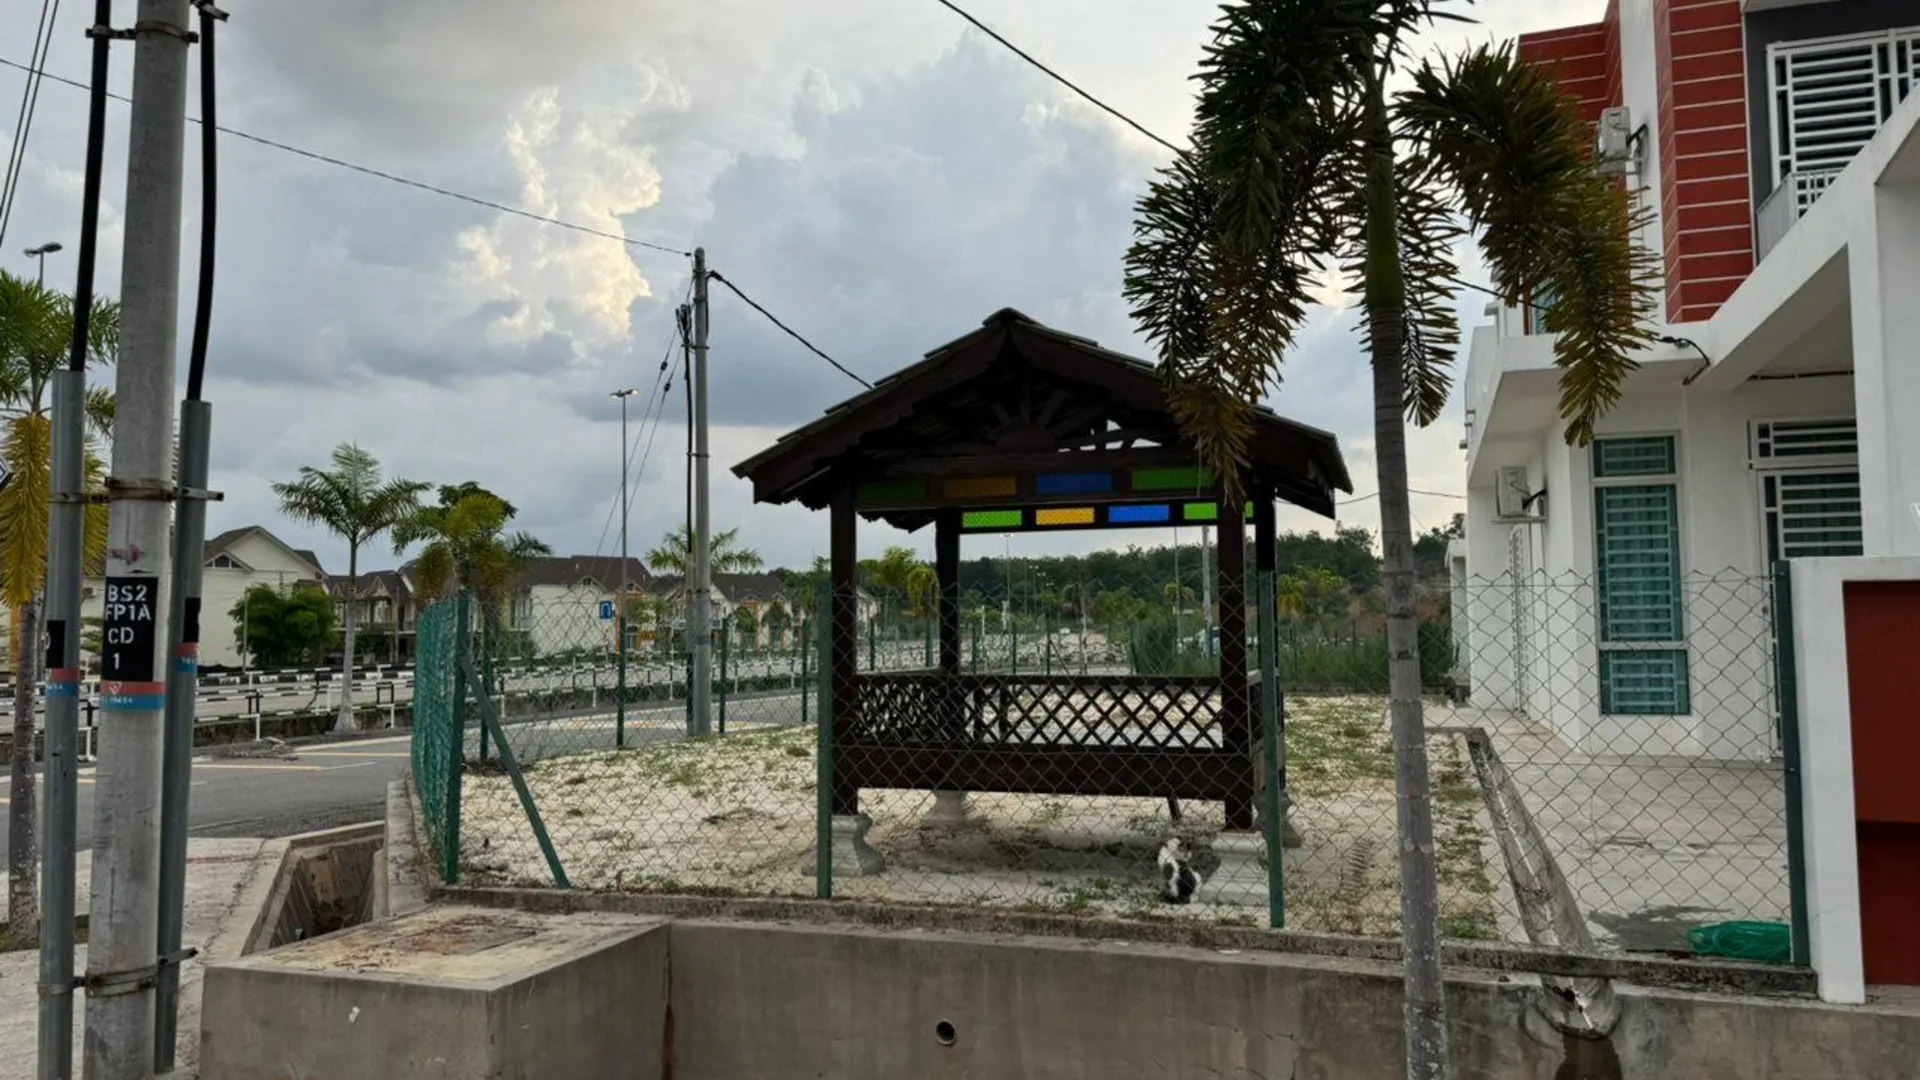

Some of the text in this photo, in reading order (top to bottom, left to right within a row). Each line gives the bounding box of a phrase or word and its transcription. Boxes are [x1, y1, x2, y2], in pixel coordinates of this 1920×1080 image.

[108, 584, 147, 602] BS2
[105, 604, 151, 621] FP1A
[108, 626, 134, 645] CD
[113, 652, 120, 670] 1
